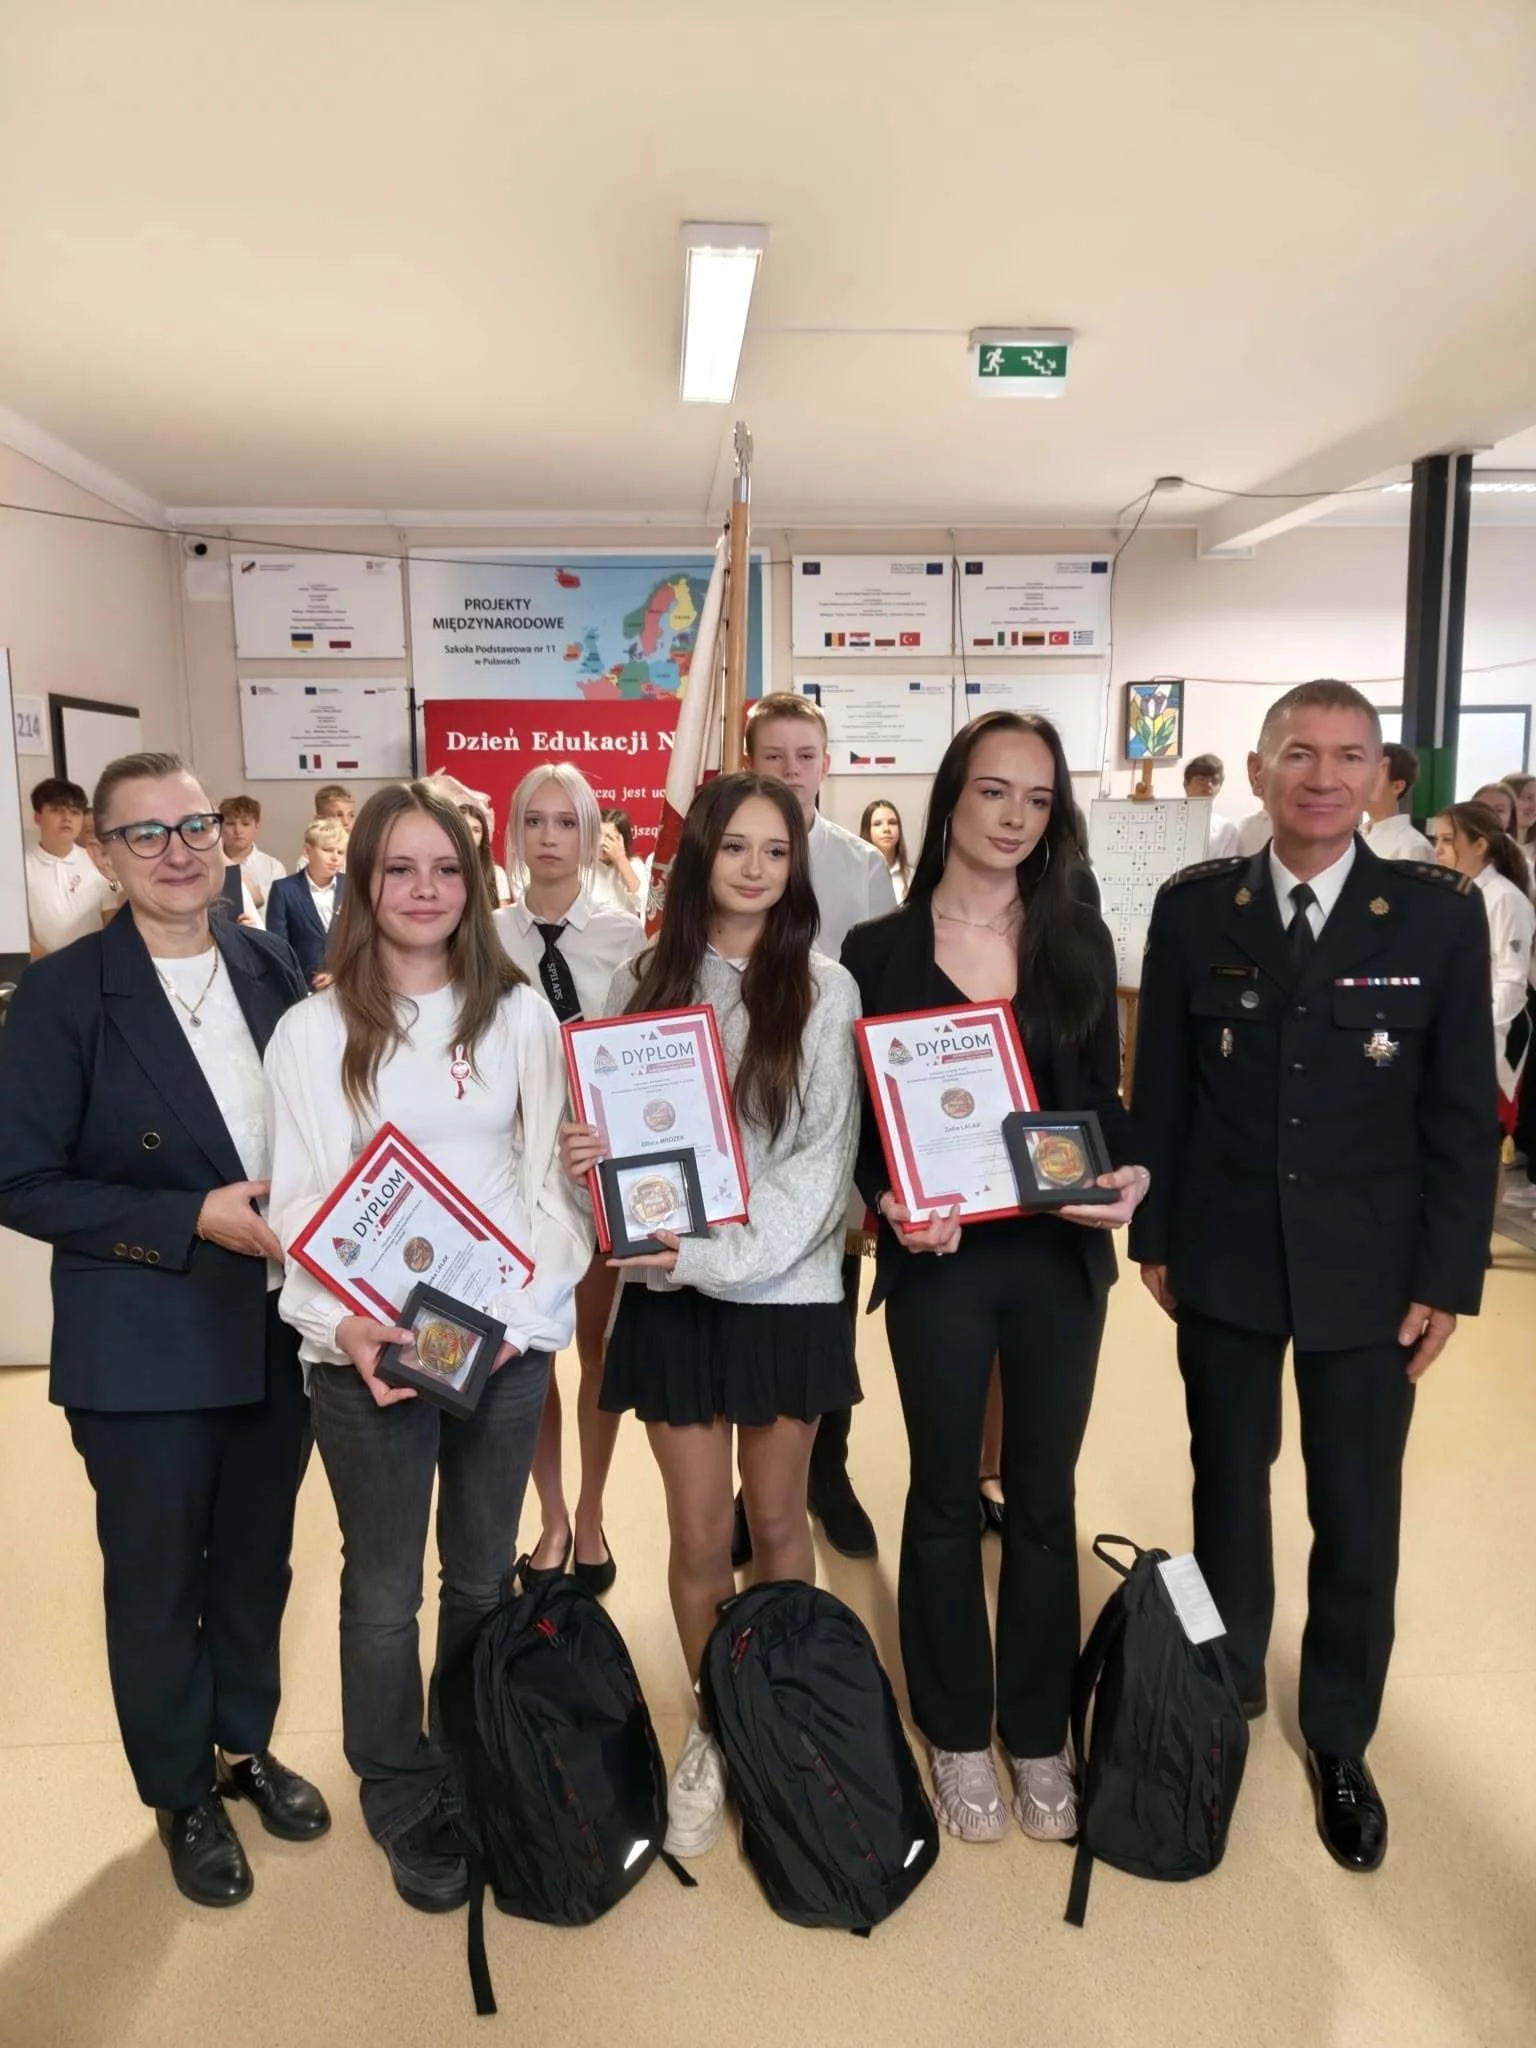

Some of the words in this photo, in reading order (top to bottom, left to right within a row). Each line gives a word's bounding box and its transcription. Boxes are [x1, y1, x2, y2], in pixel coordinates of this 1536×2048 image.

[464, 598, 532, 611] PROJEKTY
[433, 617, 565, 632] MIĘDZYNARODOWE
[445, 645, 474, 654] Szkoła
[475, 645, 532, 654] Podstawowa
[546, 645, 556, 653] 11
[483, 657, 521, 665] Puławach
[17, 712, 41, 738] 214
[446, 728, 520, 751] Dzień
[532, 730, 649, 755] Edukacji
[620, 786, 647, 802] jest
[622, 1041, 694, 1065] DYPLOM
[916, 1033, 991, 1056] DYPLOM
[352, 1169, 406, 1238] DYPLOM
